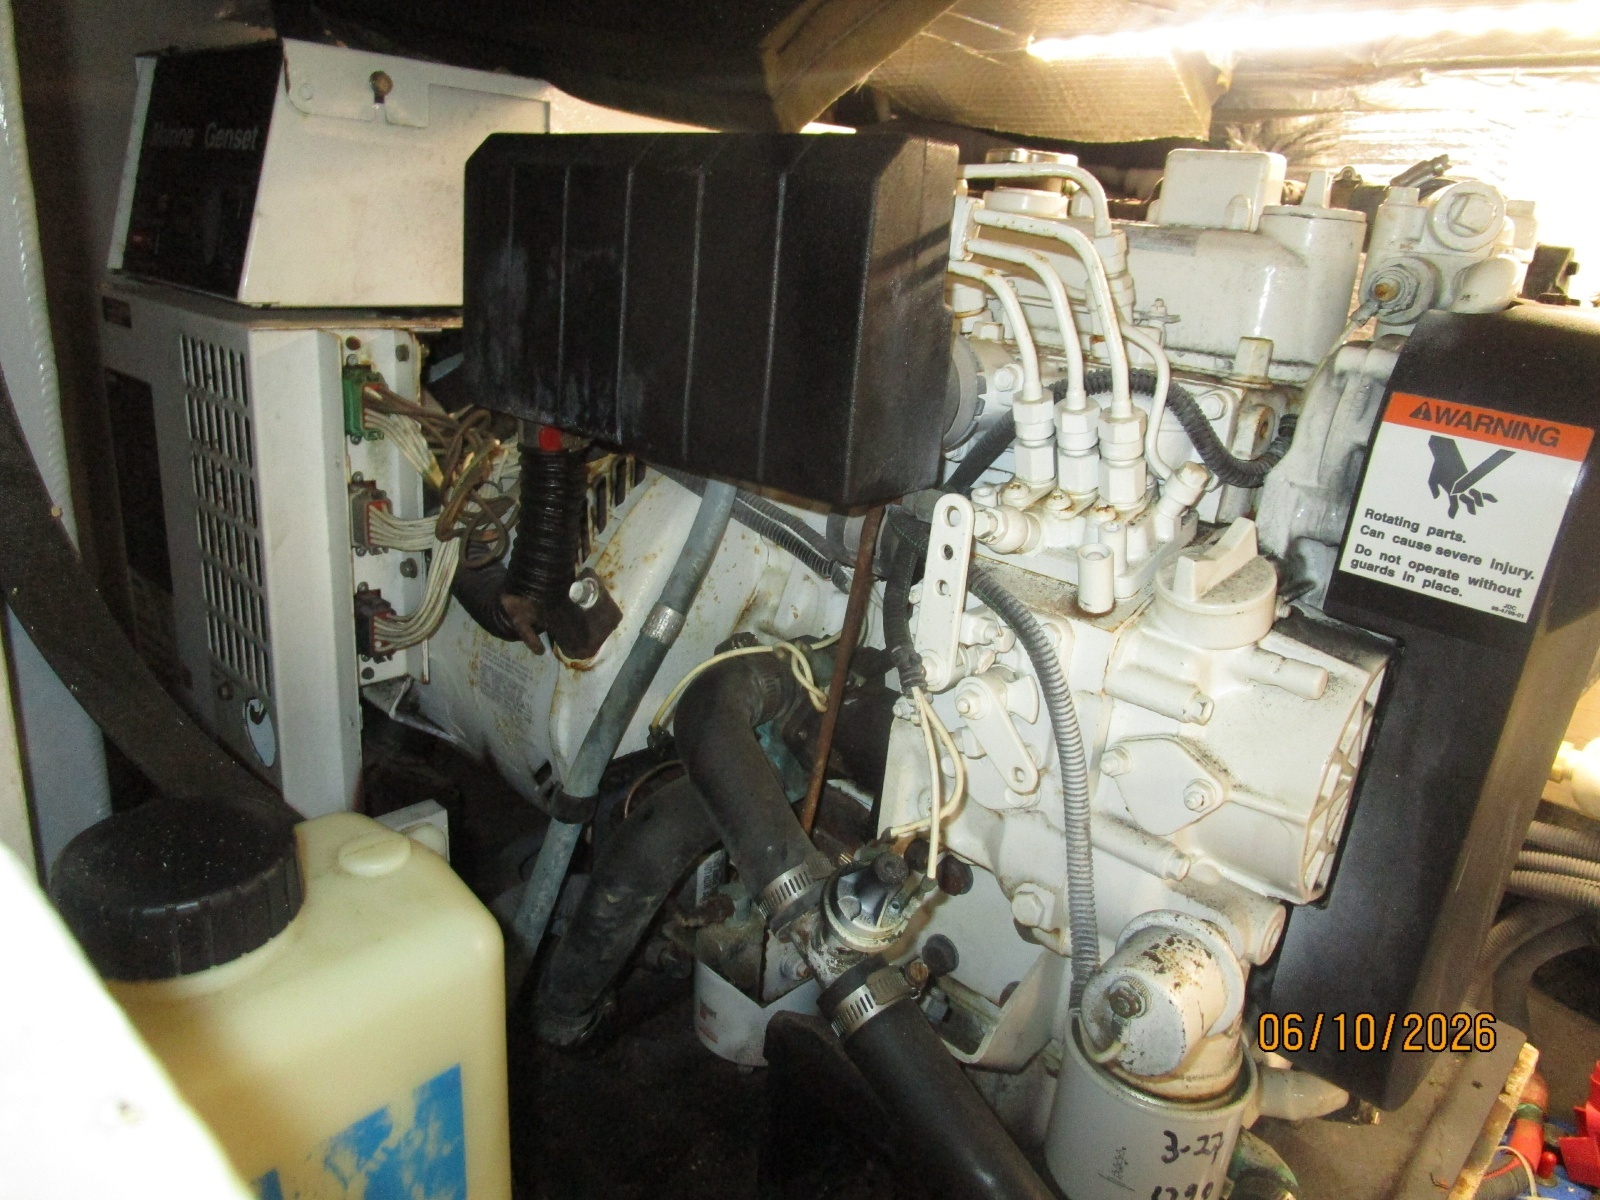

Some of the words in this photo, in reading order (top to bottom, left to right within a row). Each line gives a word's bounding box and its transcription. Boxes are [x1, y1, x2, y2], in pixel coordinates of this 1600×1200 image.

[203, 121, 259, 150] Genset
[1436, 405, 1561, 447] WARNING
[1364, 507, 1420, 533] Rotating
[1426, 525, 1467, 544] parts.
[1354, 543, 1372, 557] Do
[1379, 551, 1402, 565] not
[1408, 558, 1460, 581] operate
[1468, 574, 1523, 598] without
[1360, 524, 1385, 540] Can
[1392, 535, 1432, 552] cause
[1435, 546, 1482, 566] severe
[1490, 557, 1535, 580] injury.
[1350, 557, 1395, 578] guards
[1402, 571, 1415, 583] in
[1422, 577, 1463, 597] place.
[1503, 603, 1517, 611] JDC
[1161, 1130, 1224, 1165] 3-27
